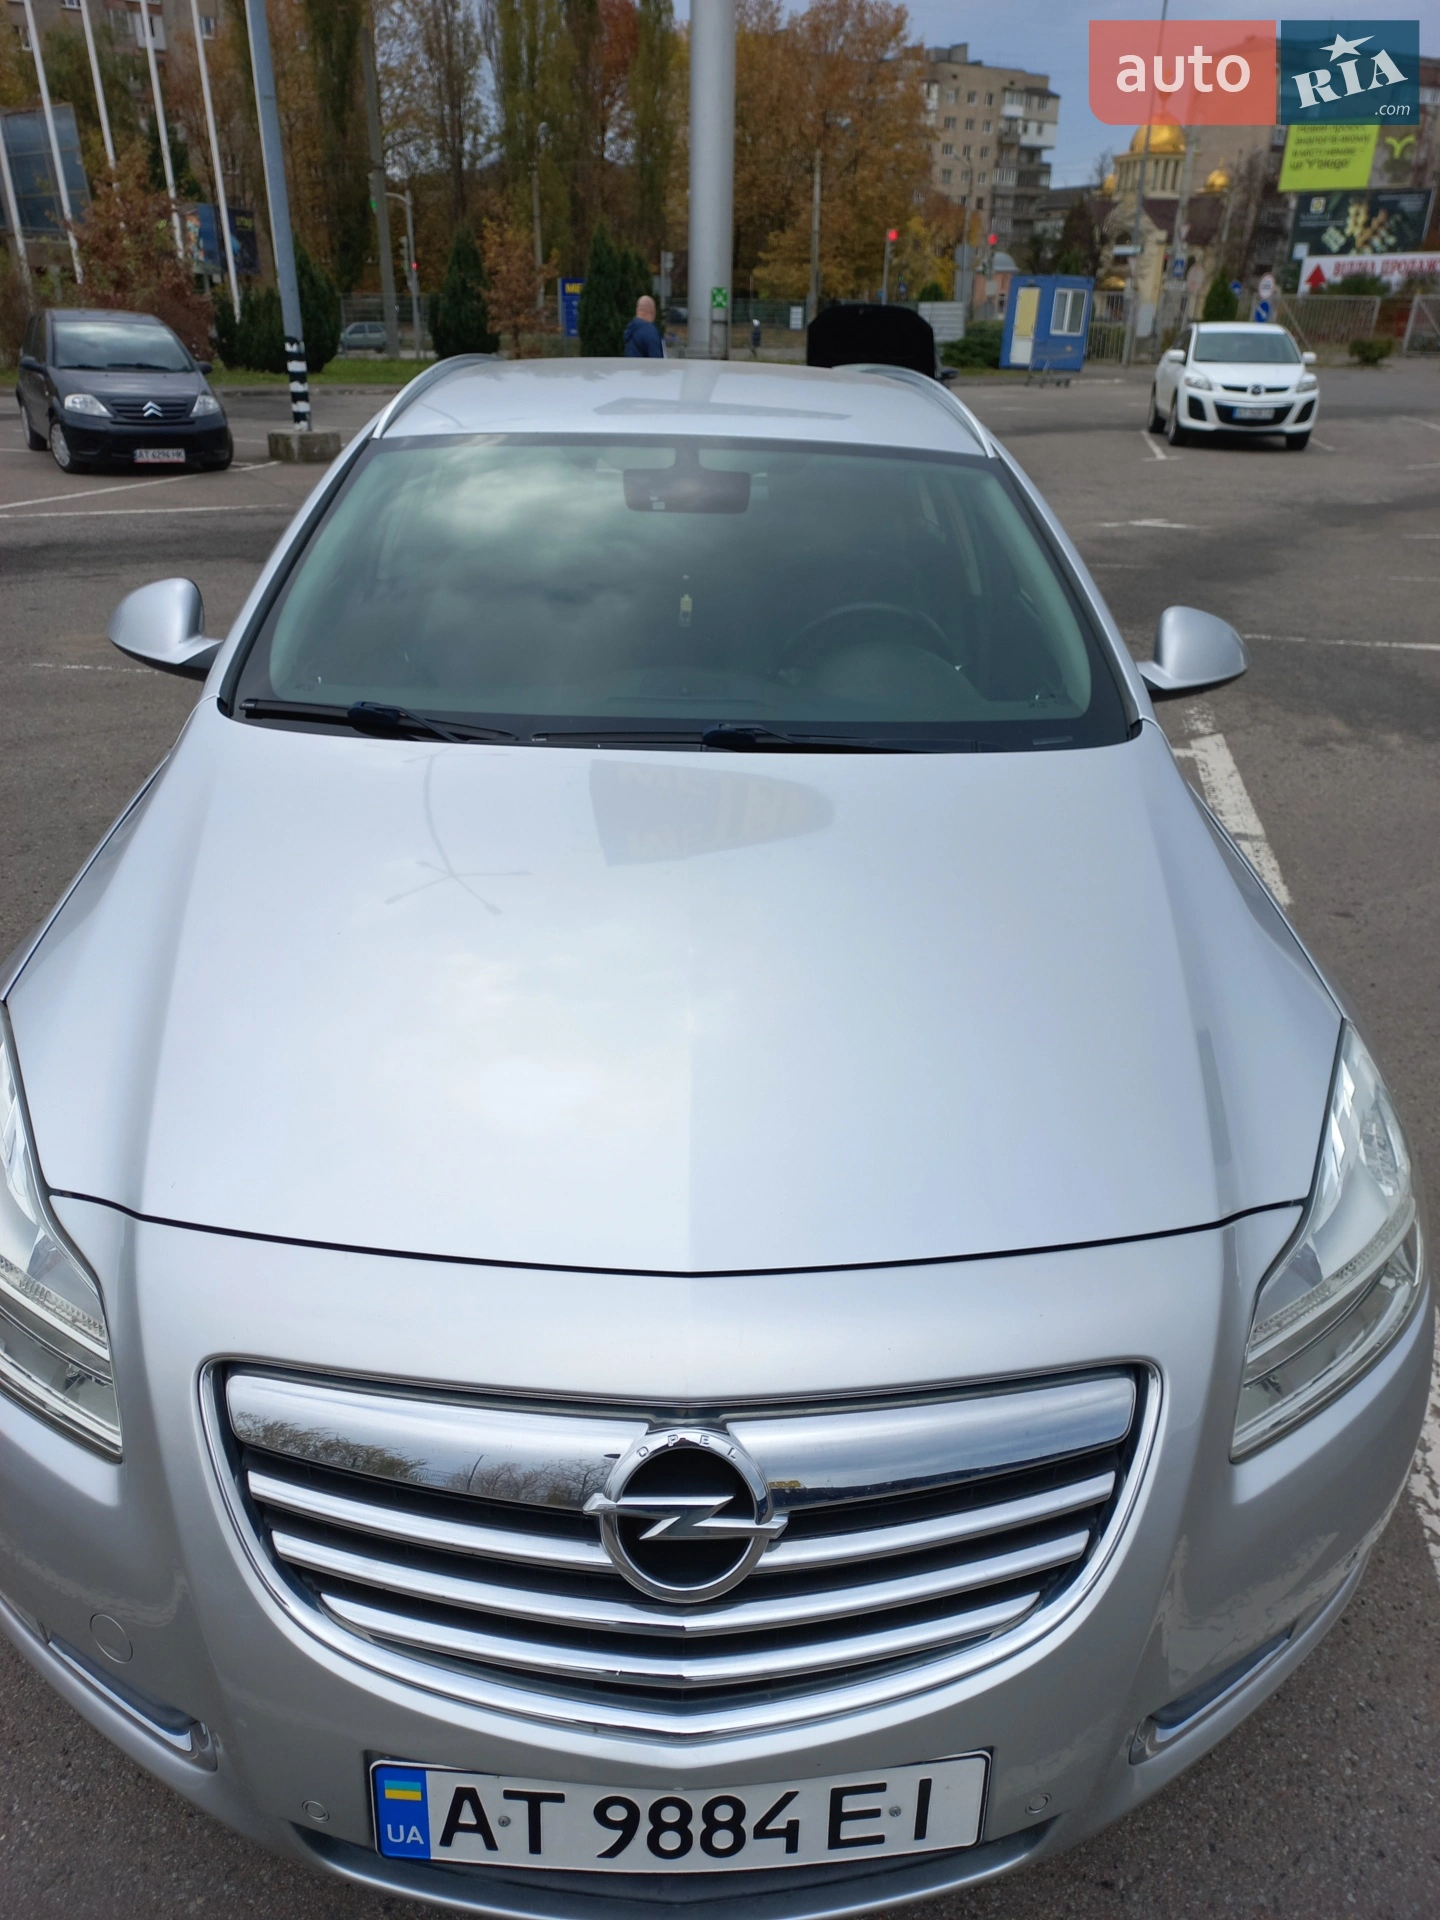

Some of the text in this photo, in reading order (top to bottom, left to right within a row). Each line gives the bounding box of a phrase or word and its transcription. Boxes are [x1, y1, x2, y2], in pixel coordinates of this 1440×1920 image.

[1381, 258, 1440, 278] ПРОДАЖ
[636, 1434, 737, 1461] OPEL
[439, 1777, 933, 1860] AT 9884 EI
[387, 1823, 425, 1846] UA
